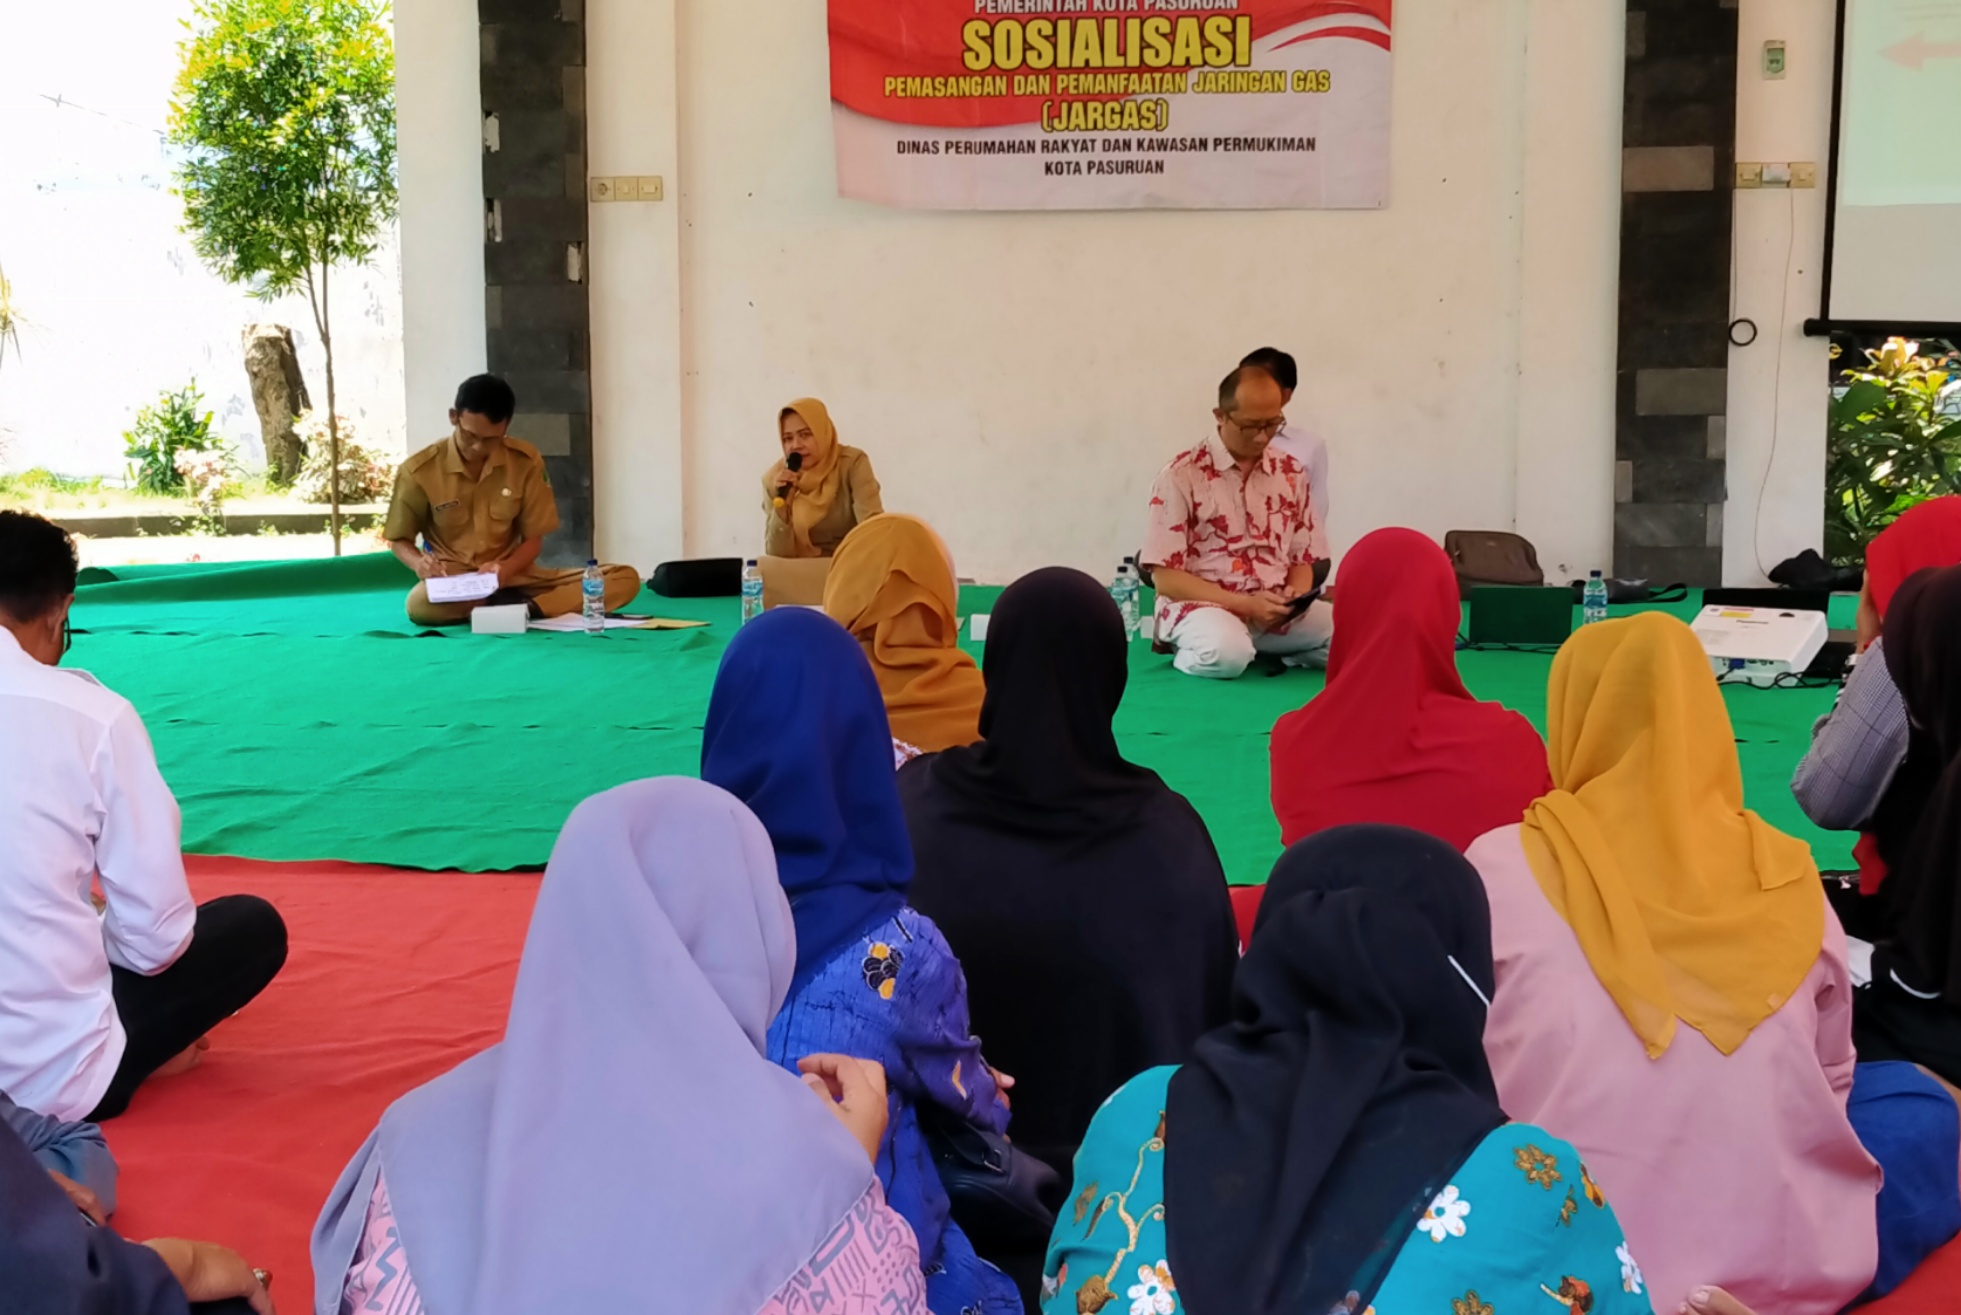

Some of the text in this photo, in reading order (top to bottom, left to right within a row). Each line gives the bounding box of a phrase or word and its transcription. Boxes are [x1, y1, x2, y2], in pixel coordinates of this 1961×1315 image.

[974, 0, 1088, 13] PEMERINTAH
[1093, 0, 1139, 12] KOTA
[962, 16, 1251, 70] SOSIALISASI
[884, 70, 1331, 97] PEMASANGAN DAN PEMANFAATAN JARINGAN GAS
[1041, 98, 1169, 132] (JARGAS)
[897, 136, 1316, 154] DINAS PERUMAHAN RAKYAT DAN KAWASAN PERMUKIMAN
[1045, 160, 1164, 176] KOTA PASURUAN
